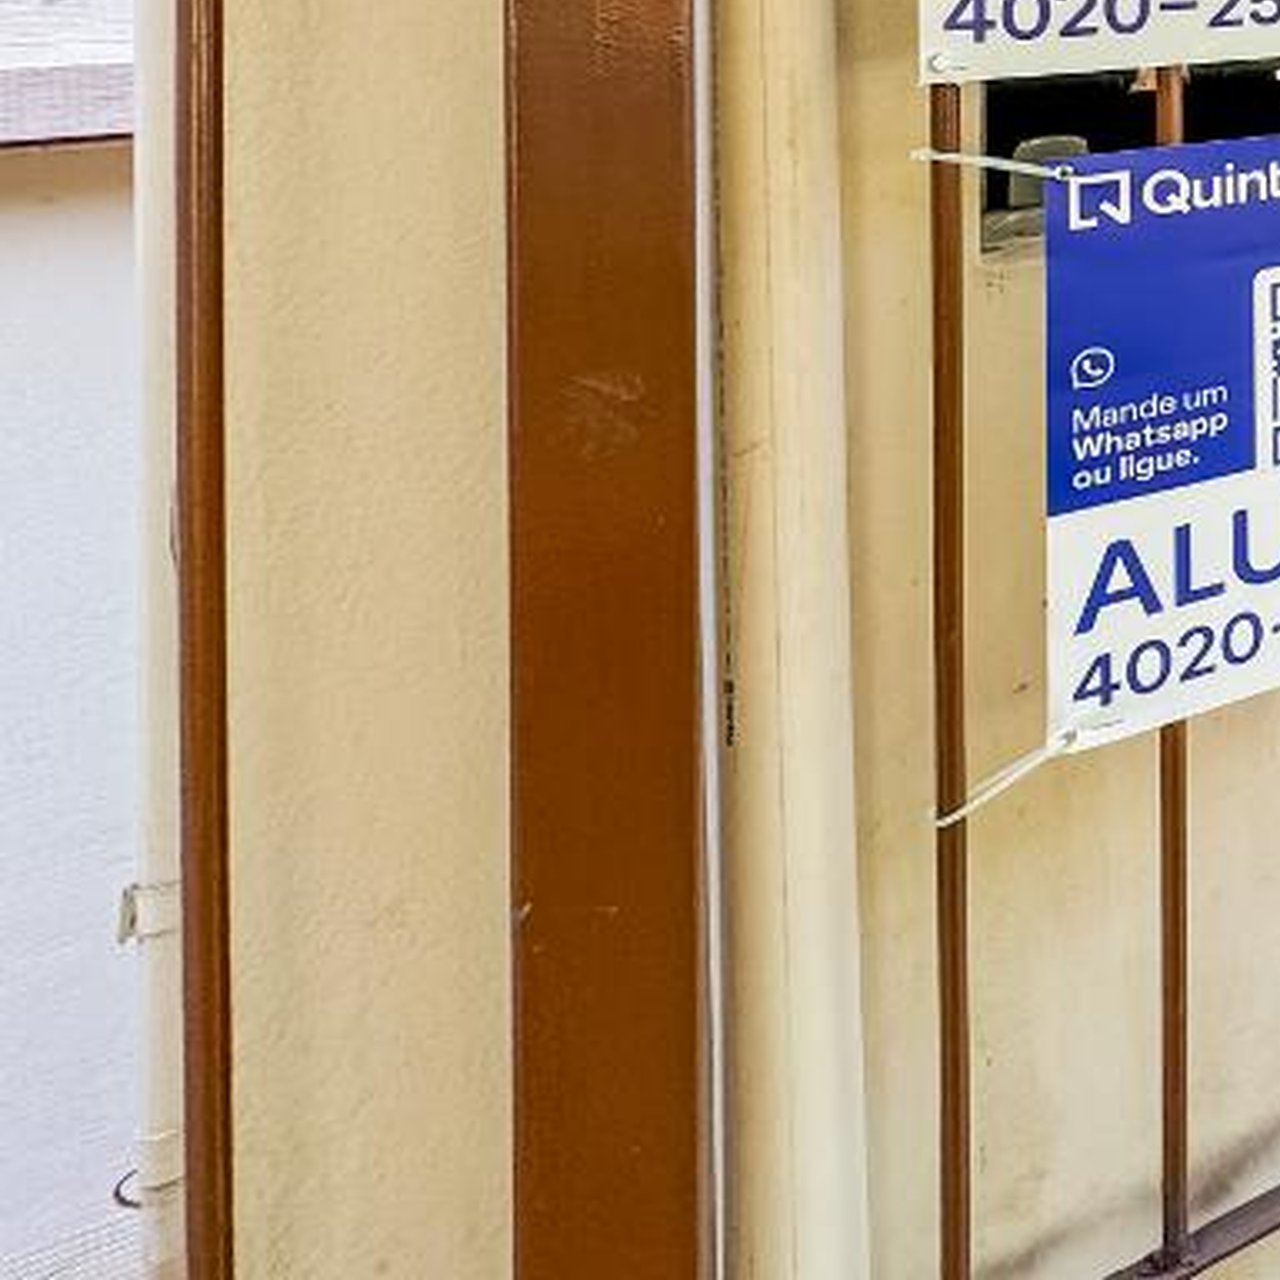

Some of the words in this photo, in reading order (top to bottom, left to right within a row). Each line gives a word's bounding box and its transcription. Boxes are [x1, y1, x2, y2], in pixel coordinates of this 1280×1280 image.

[1071, 395, 1176, 434] Mande
[1183, 384, 1227, 412] um
[1072, 412, 1229, 461] Whatsapp
[1072, 465, 1111, 490] ou
[1119, 448, 1199, 484] ligue.
